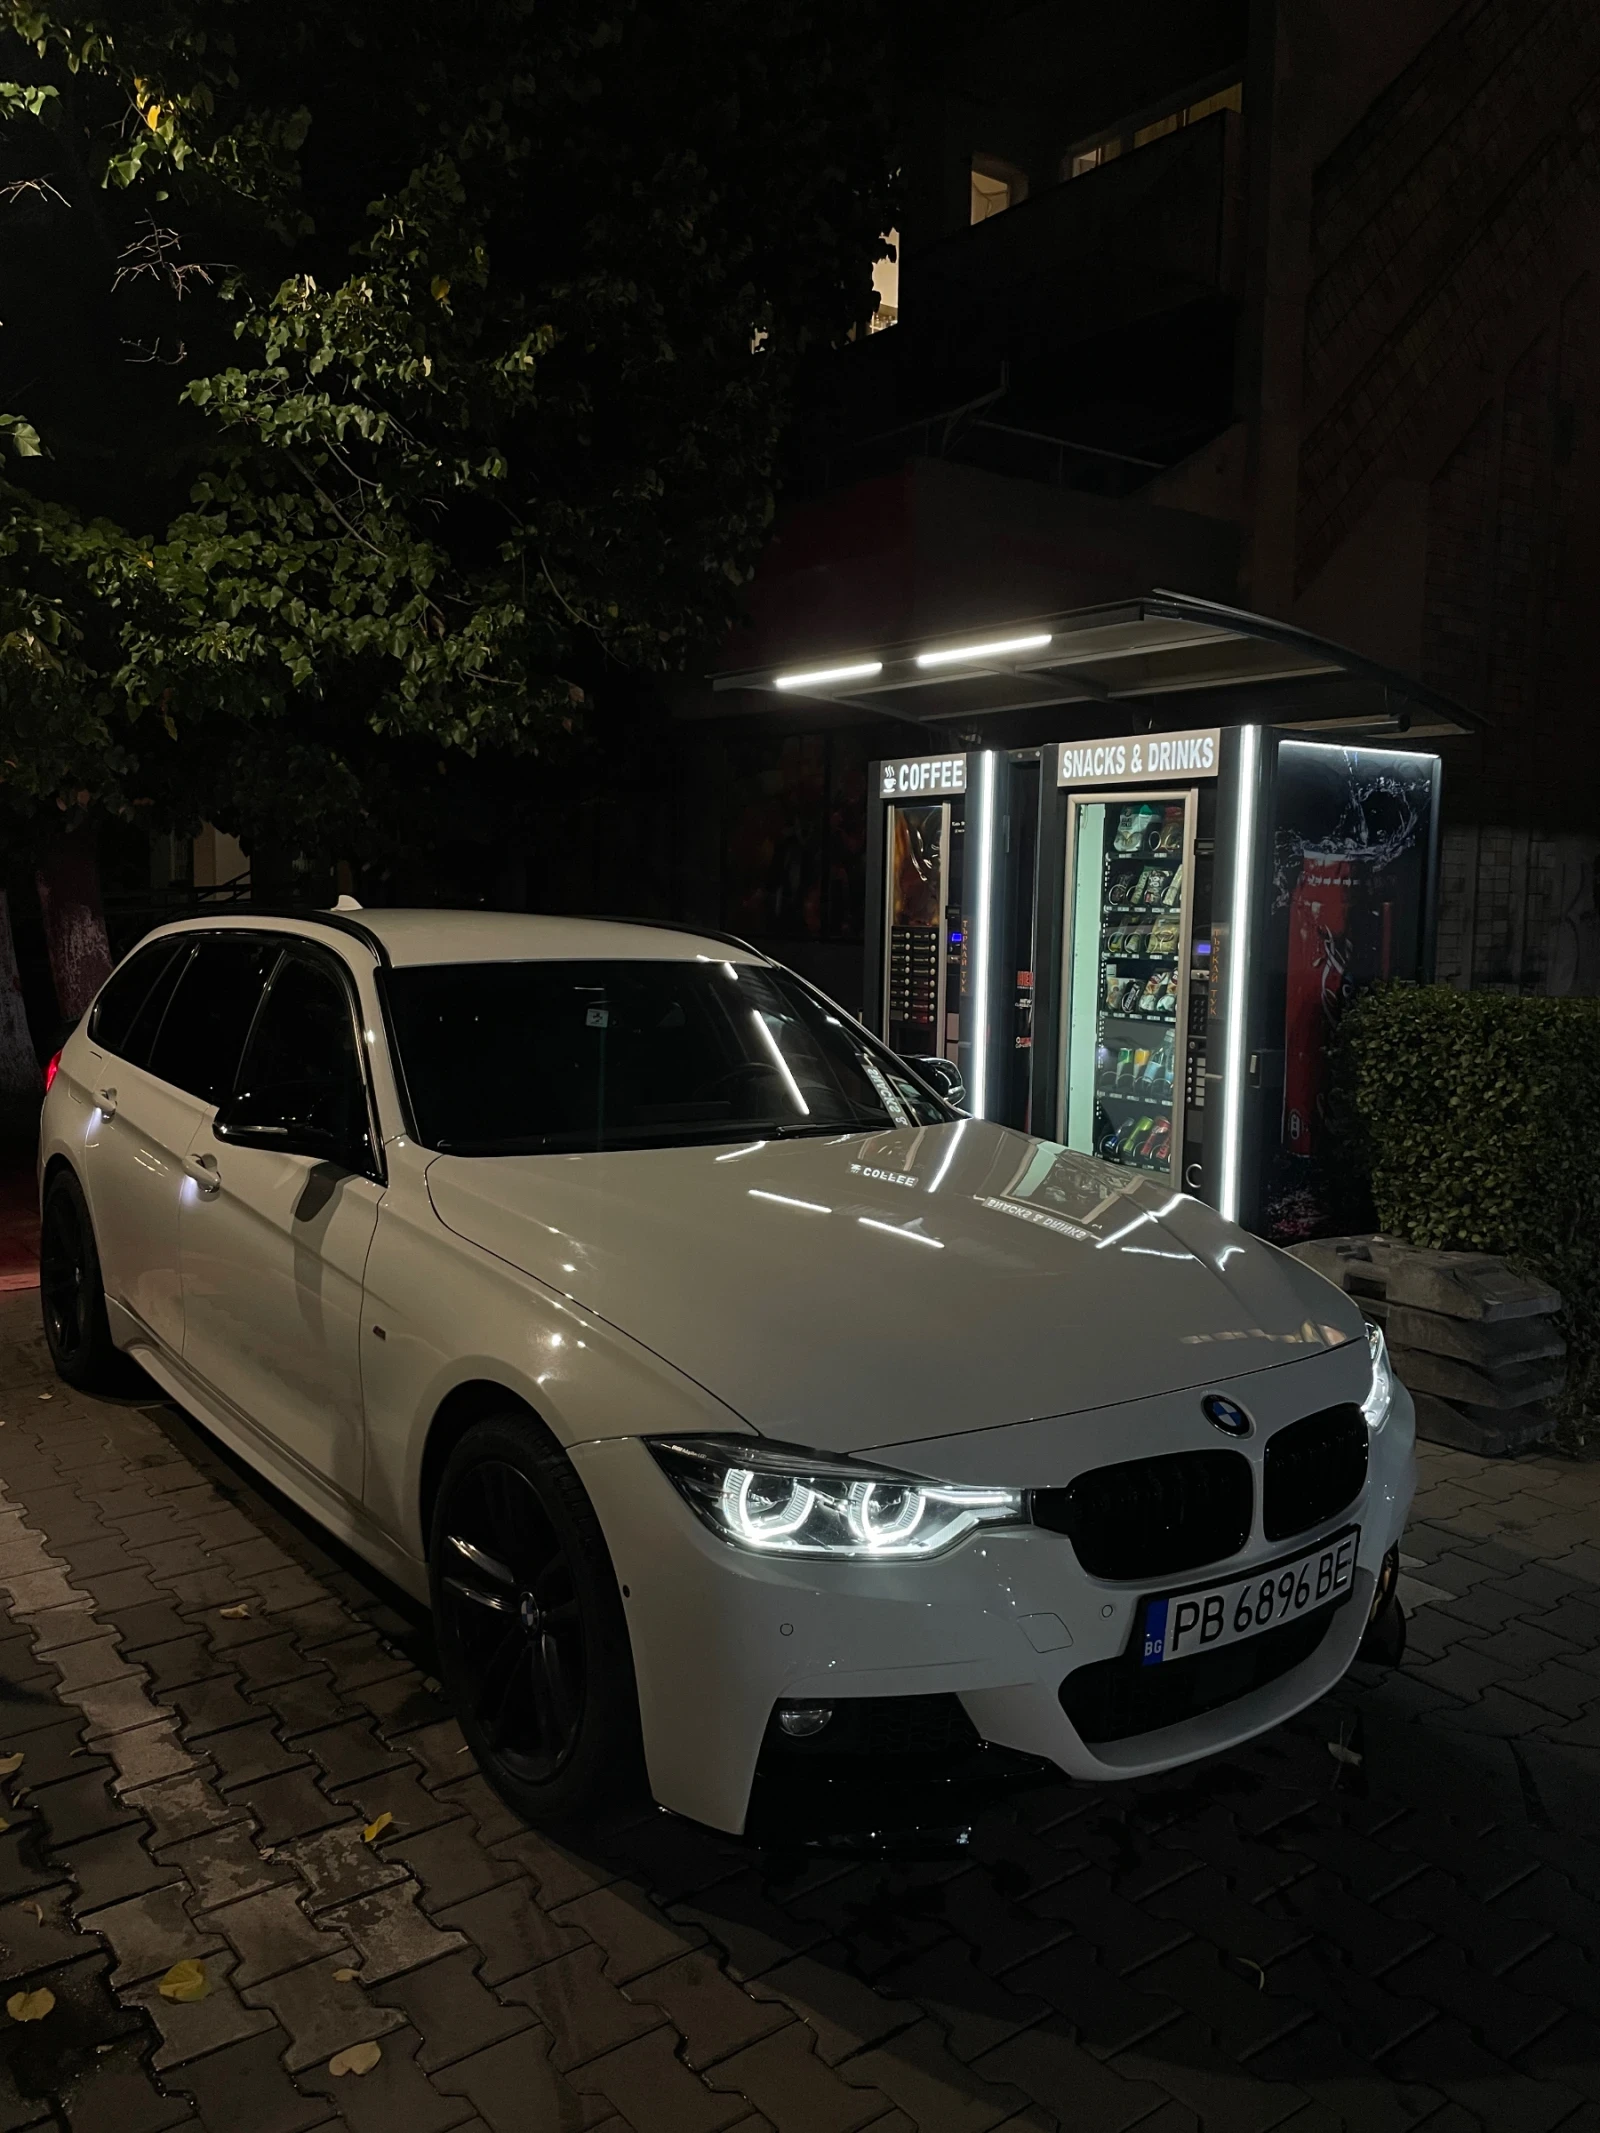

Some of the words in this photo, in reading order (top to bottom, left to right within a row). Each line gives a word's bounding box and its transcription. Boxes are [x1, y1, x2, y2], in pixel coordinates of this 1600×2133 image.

[1062, 745, 1126, 778] SNACKS
[1130, 743, 1143, 774] &
[1147, 737, 1214, 772] DRINKS
[899, 760, 964, 791] COFFEE
[1209, 989, 1218, 1015] ТУК
[1172, 1595, 1225, 1651] PB
[1233, 1563, 1310, 1632] 6896
[1316, 1540, 1352, 1600] BE
[1144, 1639, 1163, 1657] BG
